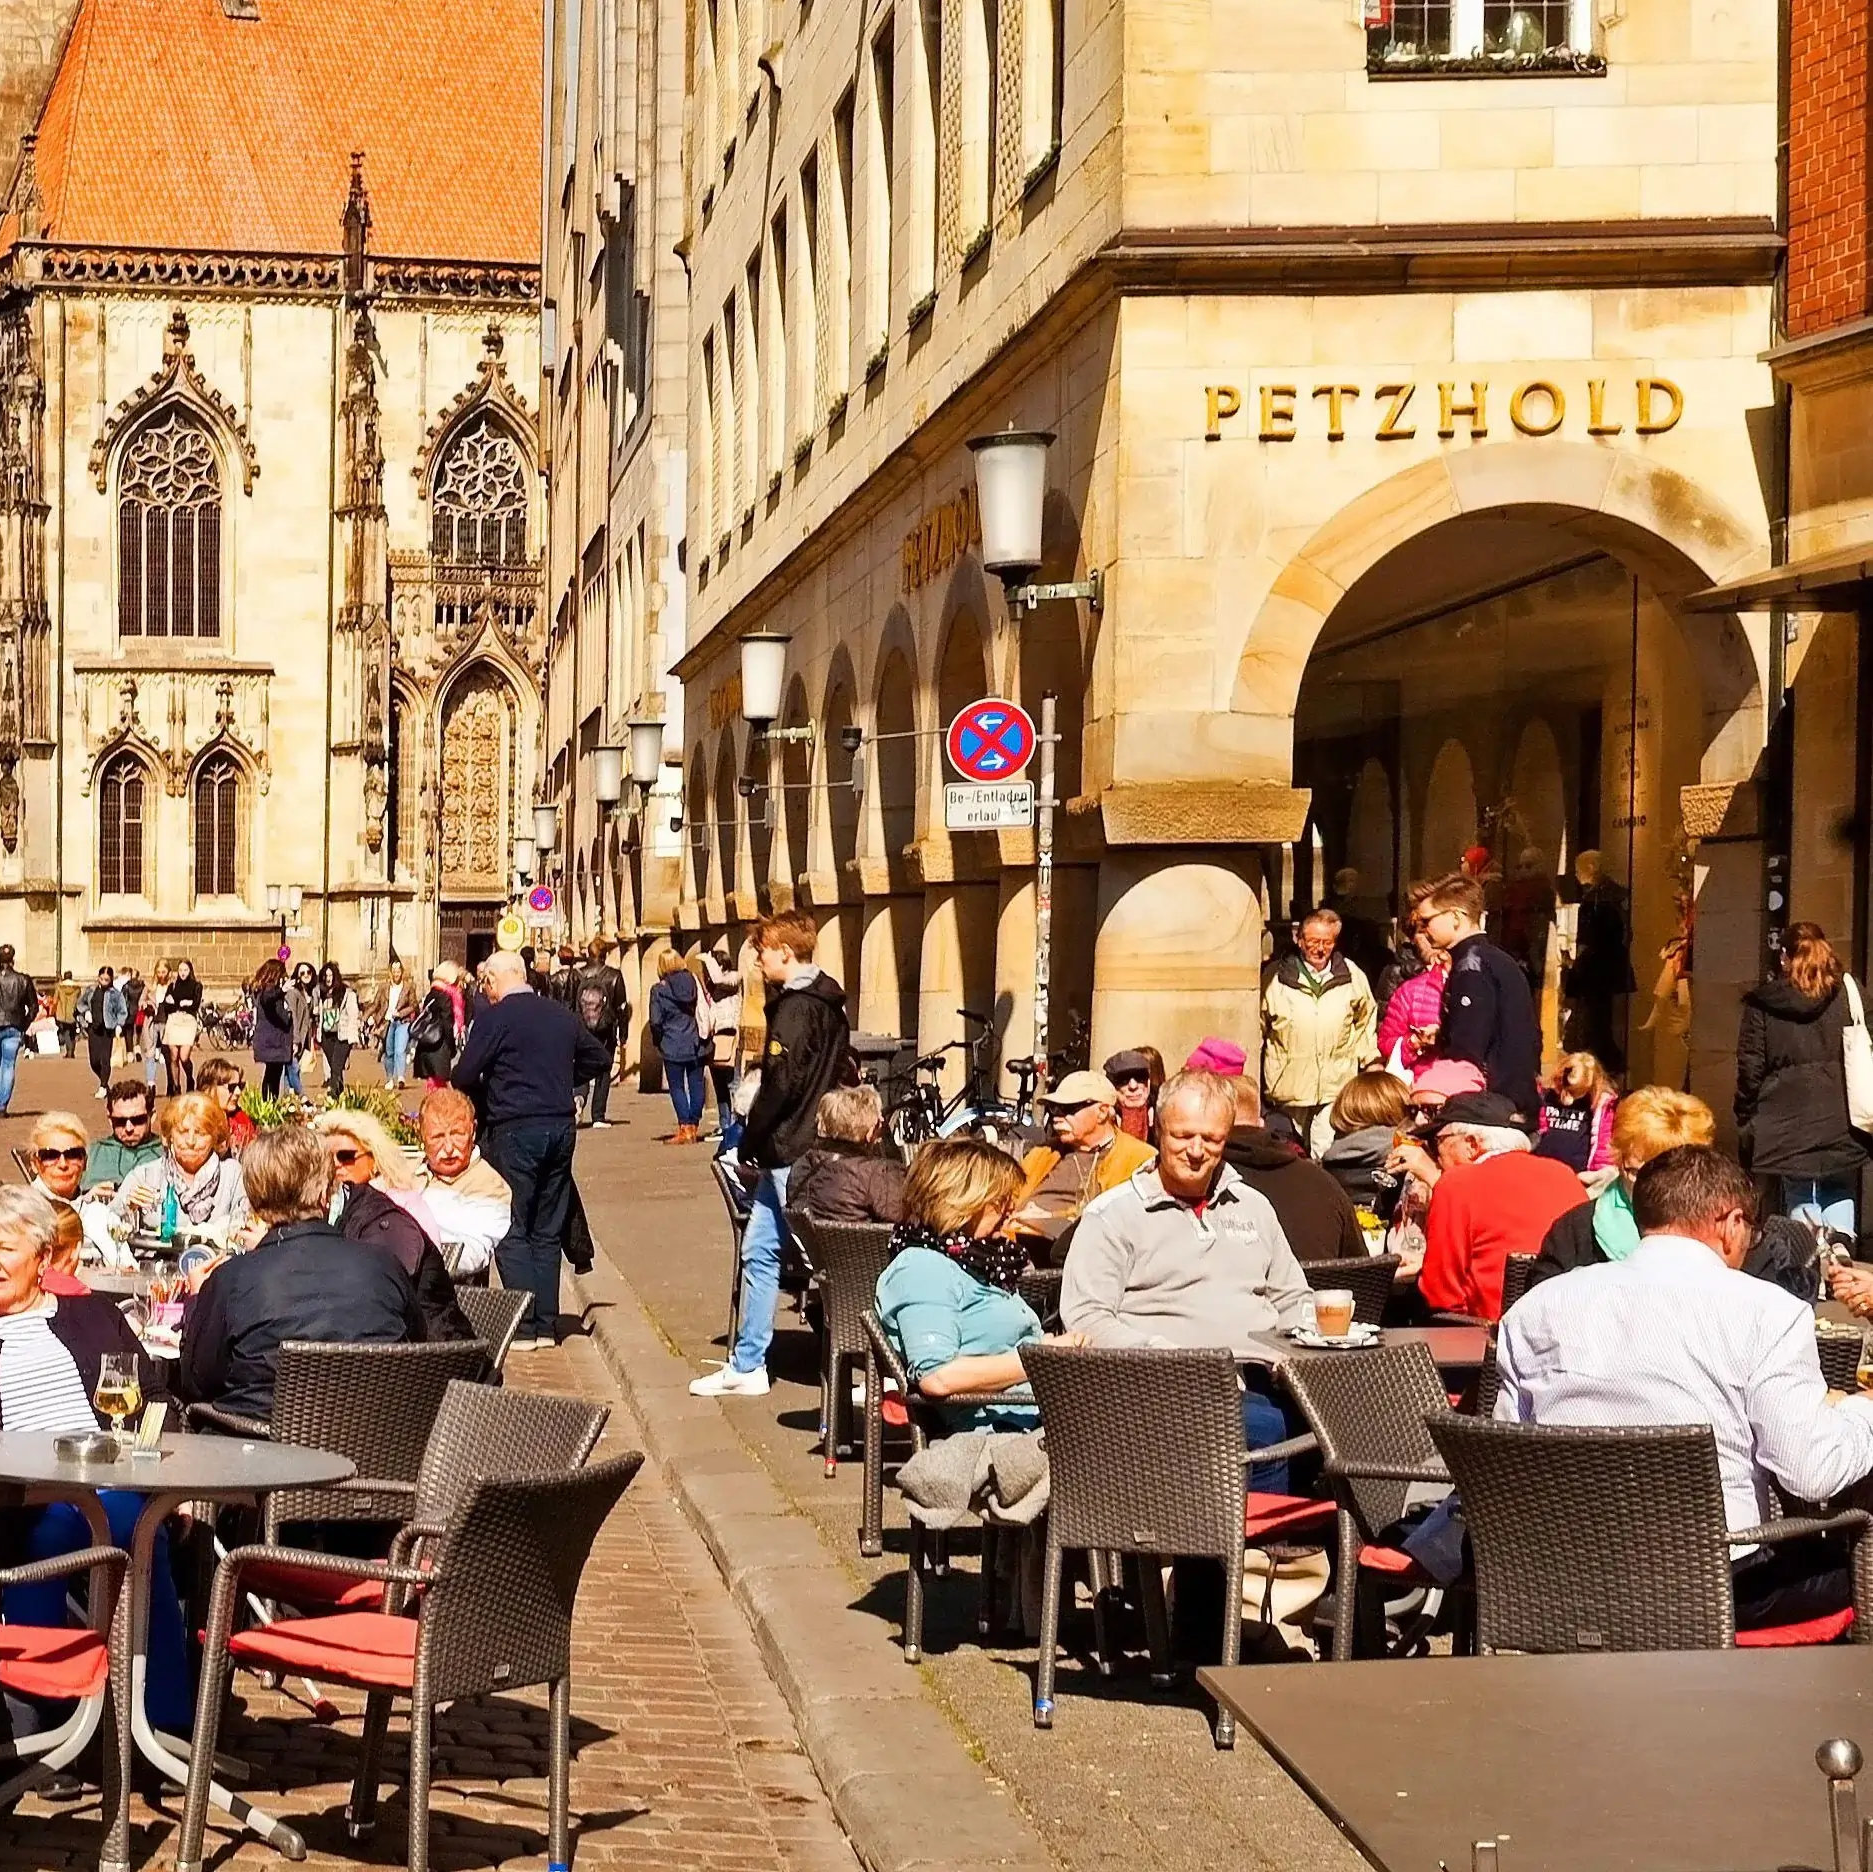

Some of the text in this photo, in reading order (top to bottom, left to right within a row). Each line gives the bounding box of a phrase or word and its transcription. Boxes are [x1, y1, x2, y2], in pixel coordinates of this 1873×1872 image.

[1204, 377, 1684, 442] PETZHOLD
[949, 789, 1028, 805] Be-/Entladen
[967, 808, 1002, 822] erlau
[1547, 1117, 1581, 1132] TIME
